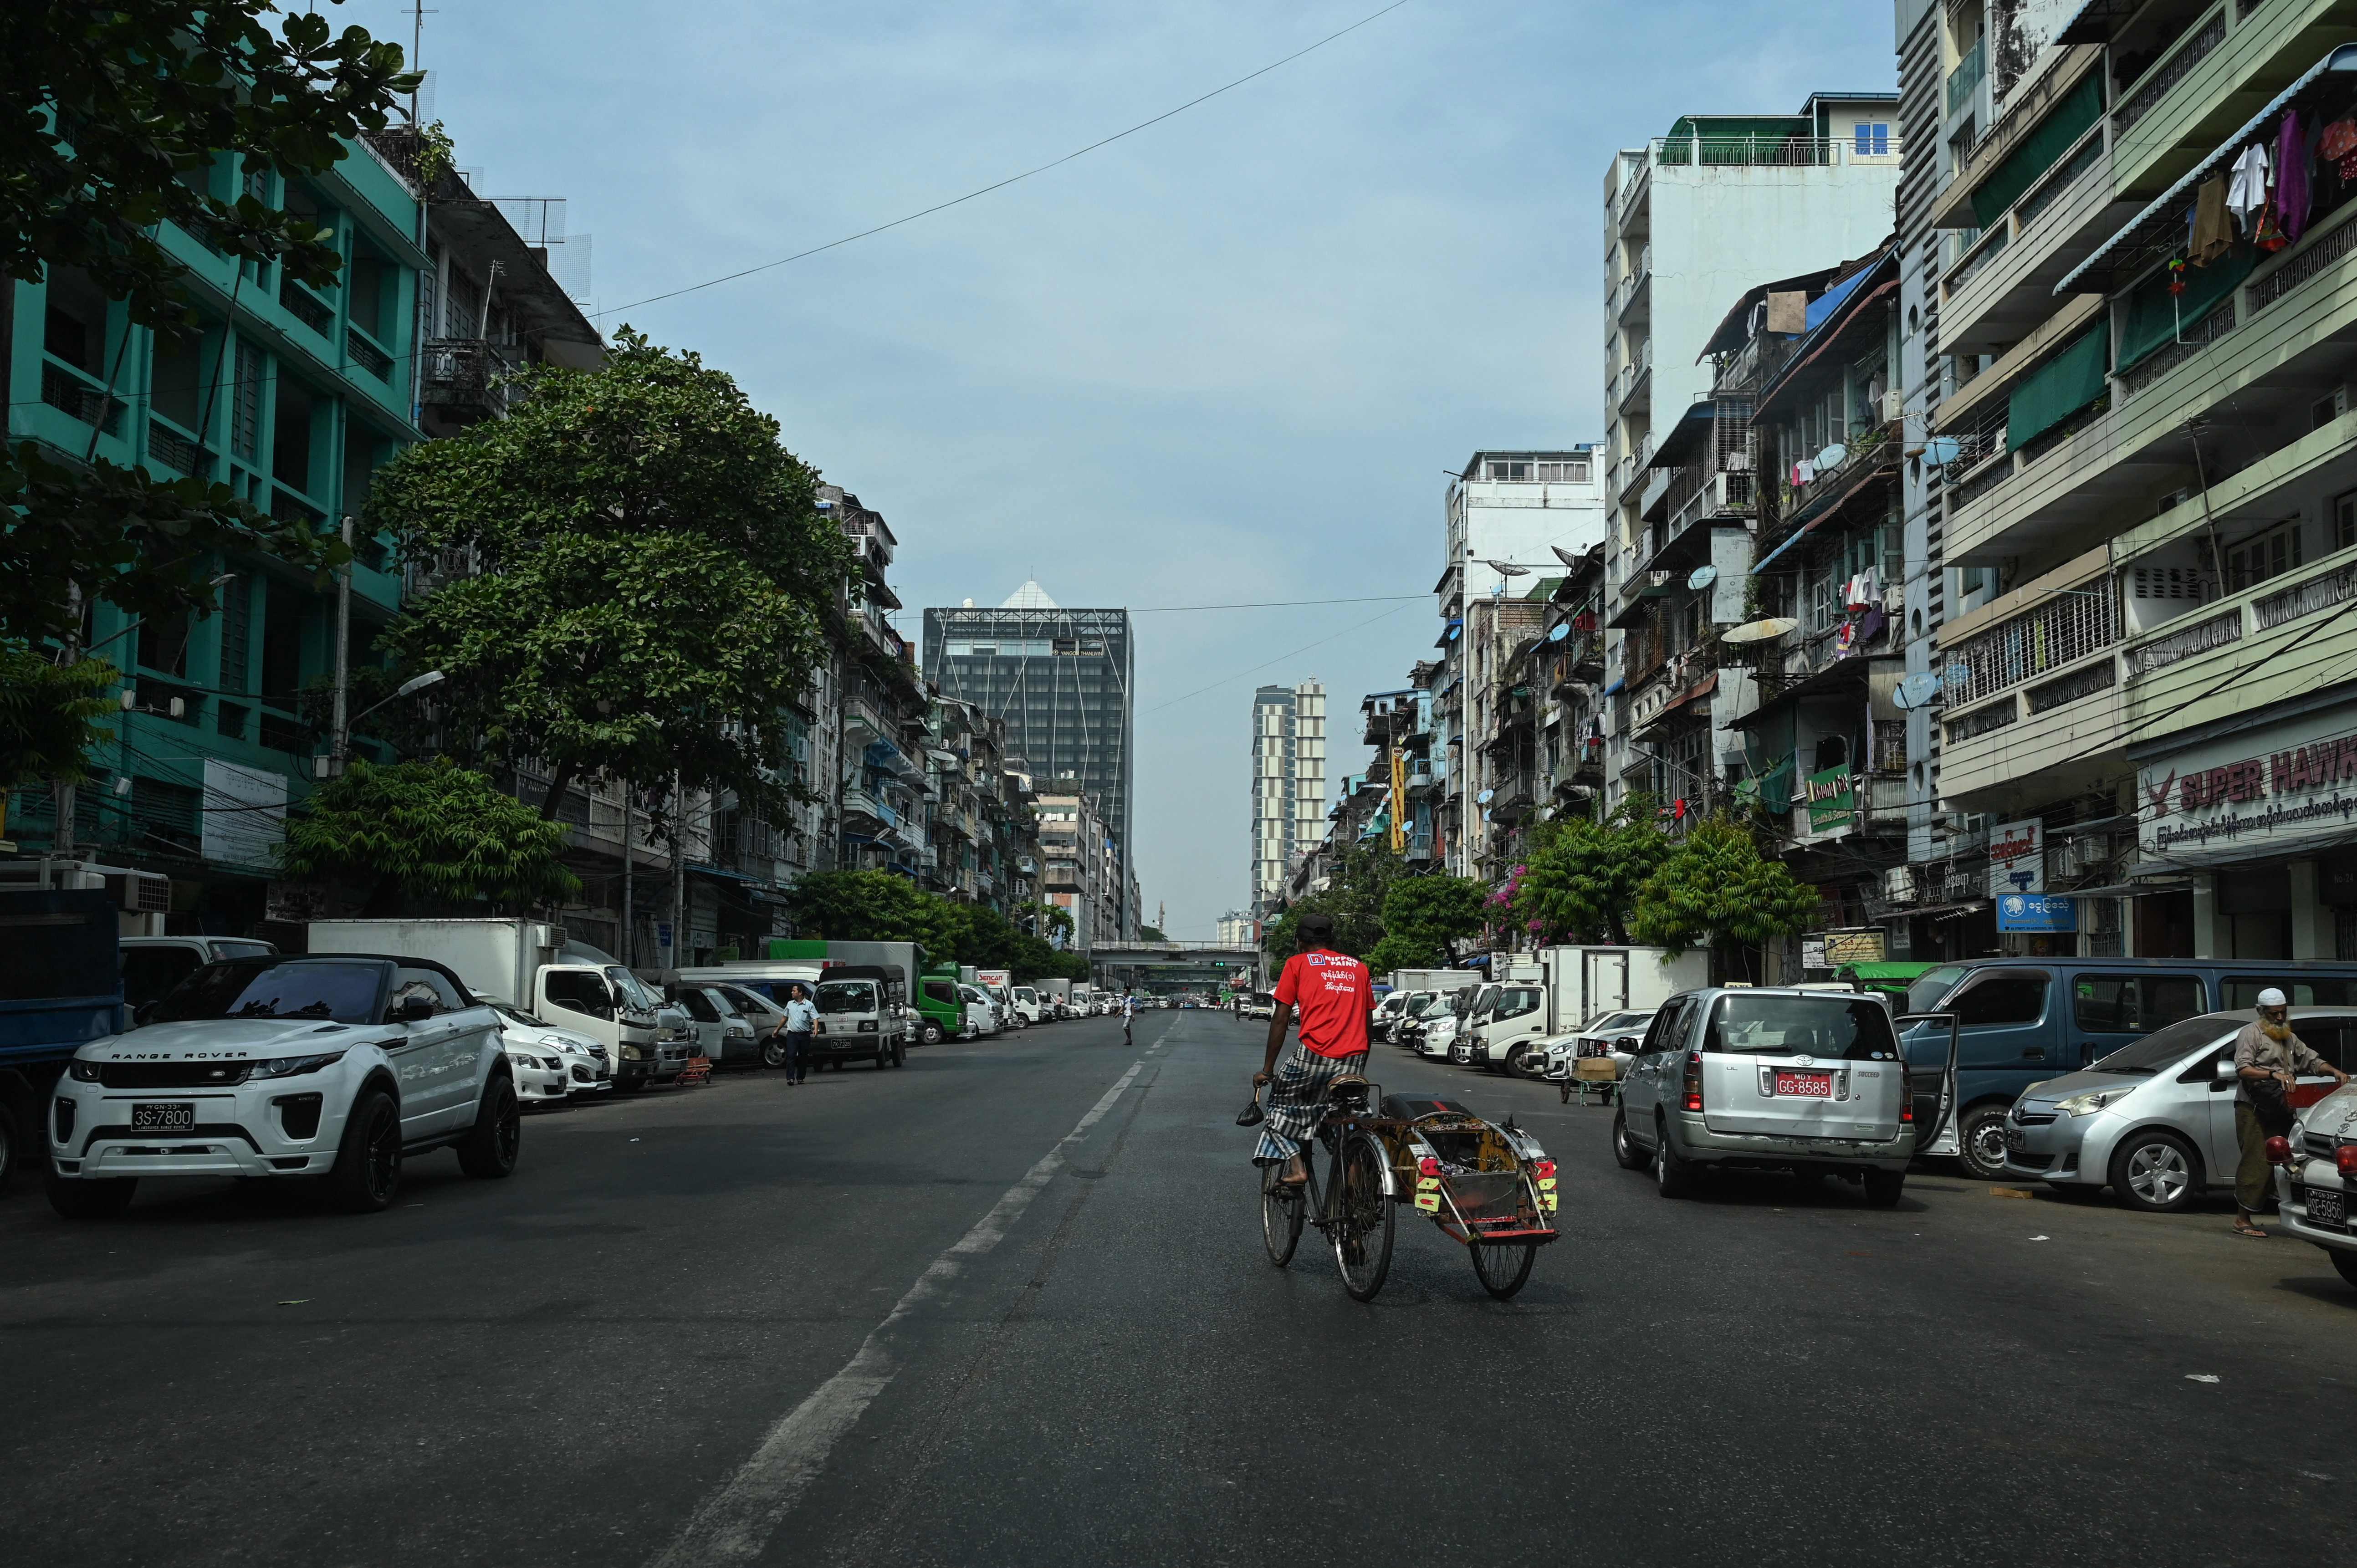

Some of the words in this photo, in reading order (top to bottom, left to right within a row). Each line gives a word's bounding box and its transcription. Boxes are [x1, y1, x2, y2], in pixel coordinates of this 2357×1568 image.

[2180, 759, 2267, 810] SUPER
[1813, 812, 1828, 827] Health
[1828, 811, 1833, 821] &
[1833, 808, 1851, 820] Beauty
[1325, 955, 1358, 964] NIPPON
[1779, 1080, 1828, 1094] GG-8585
[135, 1110, 190, 1125] 3S-7800
[2307, 1197, 2342, 1219] HSE-5956
